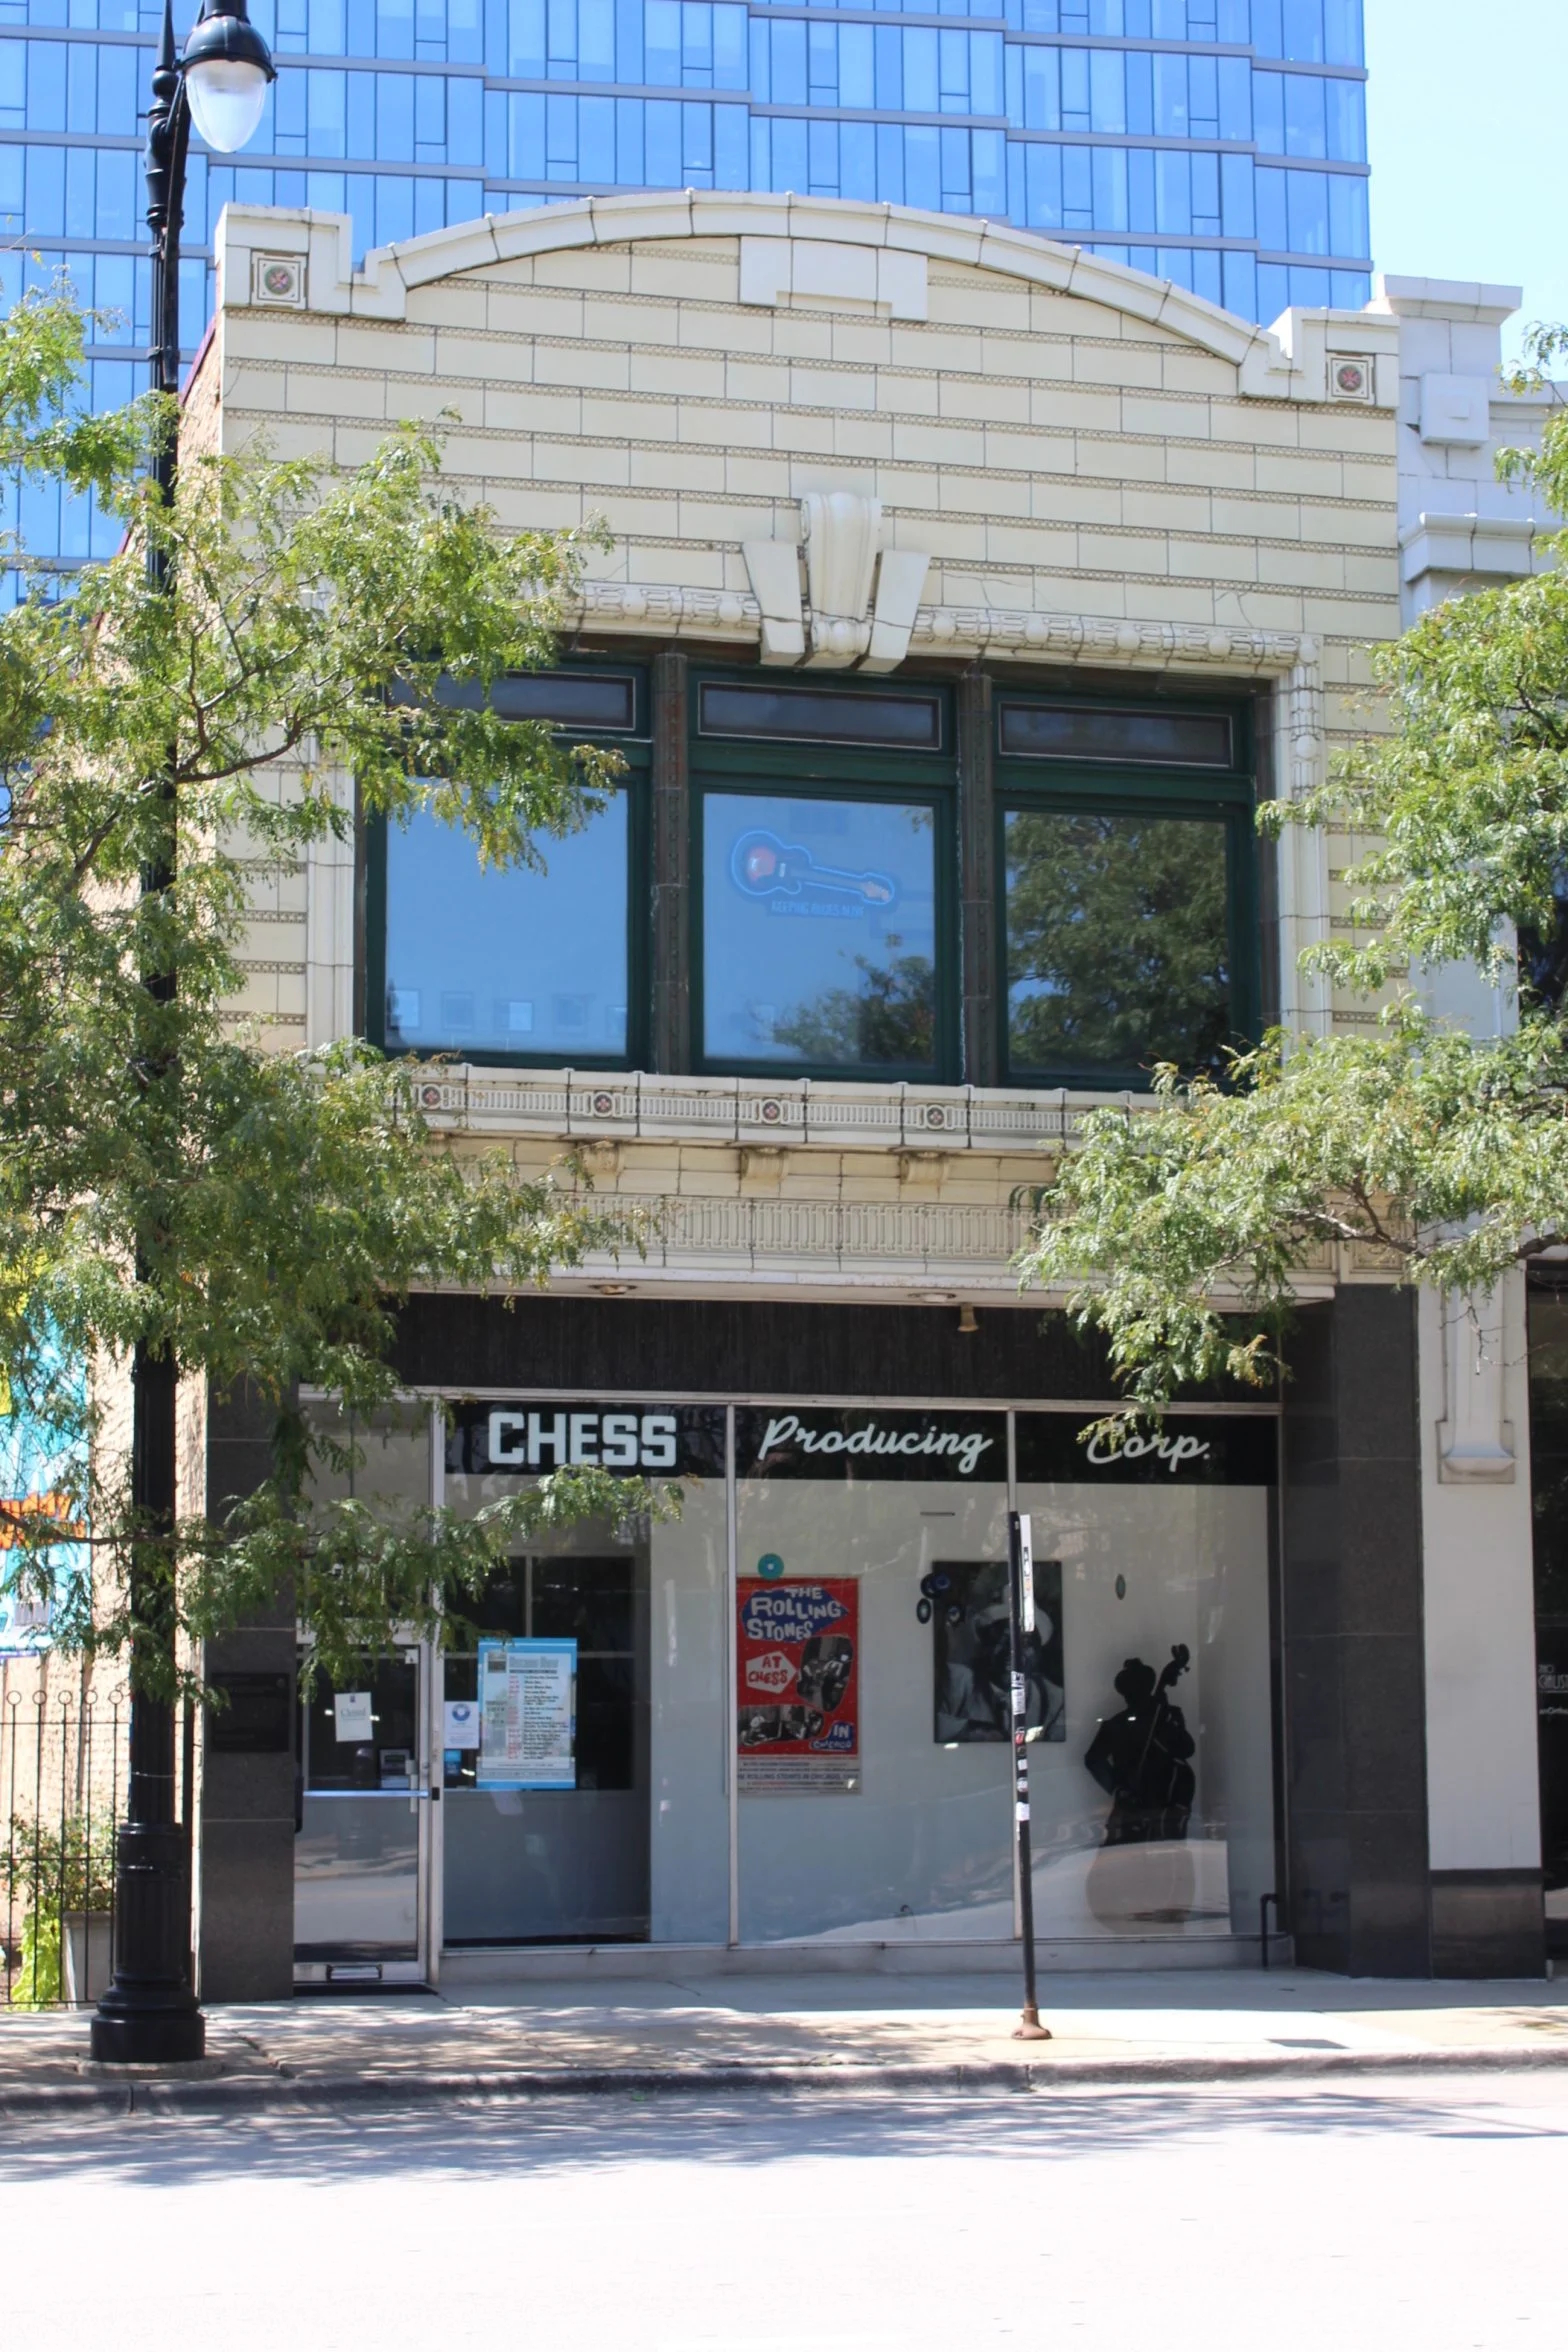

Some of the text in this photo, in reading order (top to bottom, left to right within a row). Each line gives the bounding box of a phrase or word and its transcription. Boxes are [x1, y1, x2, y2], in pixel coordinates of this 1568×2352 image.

[488, 1412, 1210, 1473] CHESS Producing Corp.
[784, 1587, 823, 1600] THE
[751, 1597, 842, 1620] ROLLING
[746, 1617, 814, 1641] STONES
[762, 1655, 782, 1668] AT
[748, 1669, 788, 1685] CHESS
[833, 1725, 849, 1738] IN
